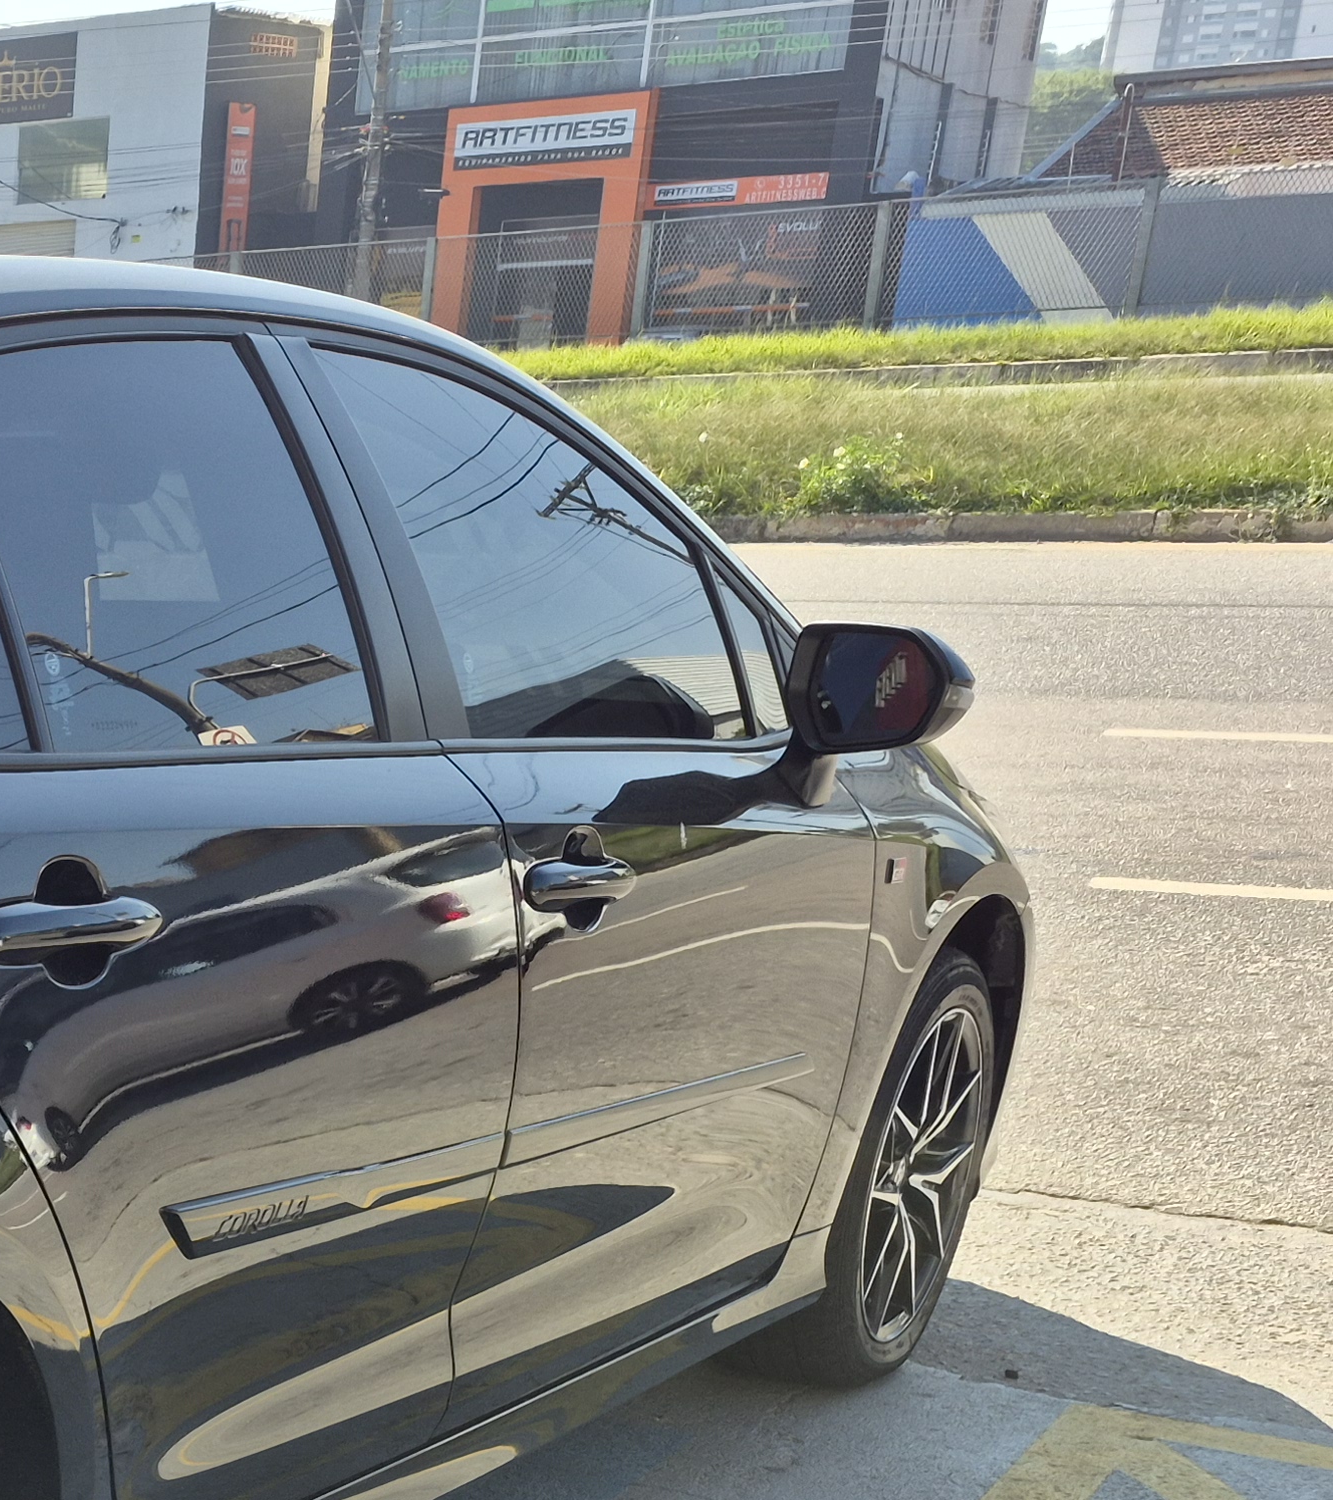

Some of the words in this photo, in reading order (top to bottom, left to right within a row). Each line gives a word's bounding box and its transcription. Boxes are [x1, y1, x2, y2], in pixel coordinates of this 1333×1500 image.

[461, 117, 629, 149] ARTFITNESS
[230, 158, 247, 175] 10X
[458, 155, 531, 167] EQUIPAMENTOS
[537, 152, 562, 161] PARA
[657, 183, 735, 198] ARTFITNESS
[213, 1195, 309, 1241] COROLLA
